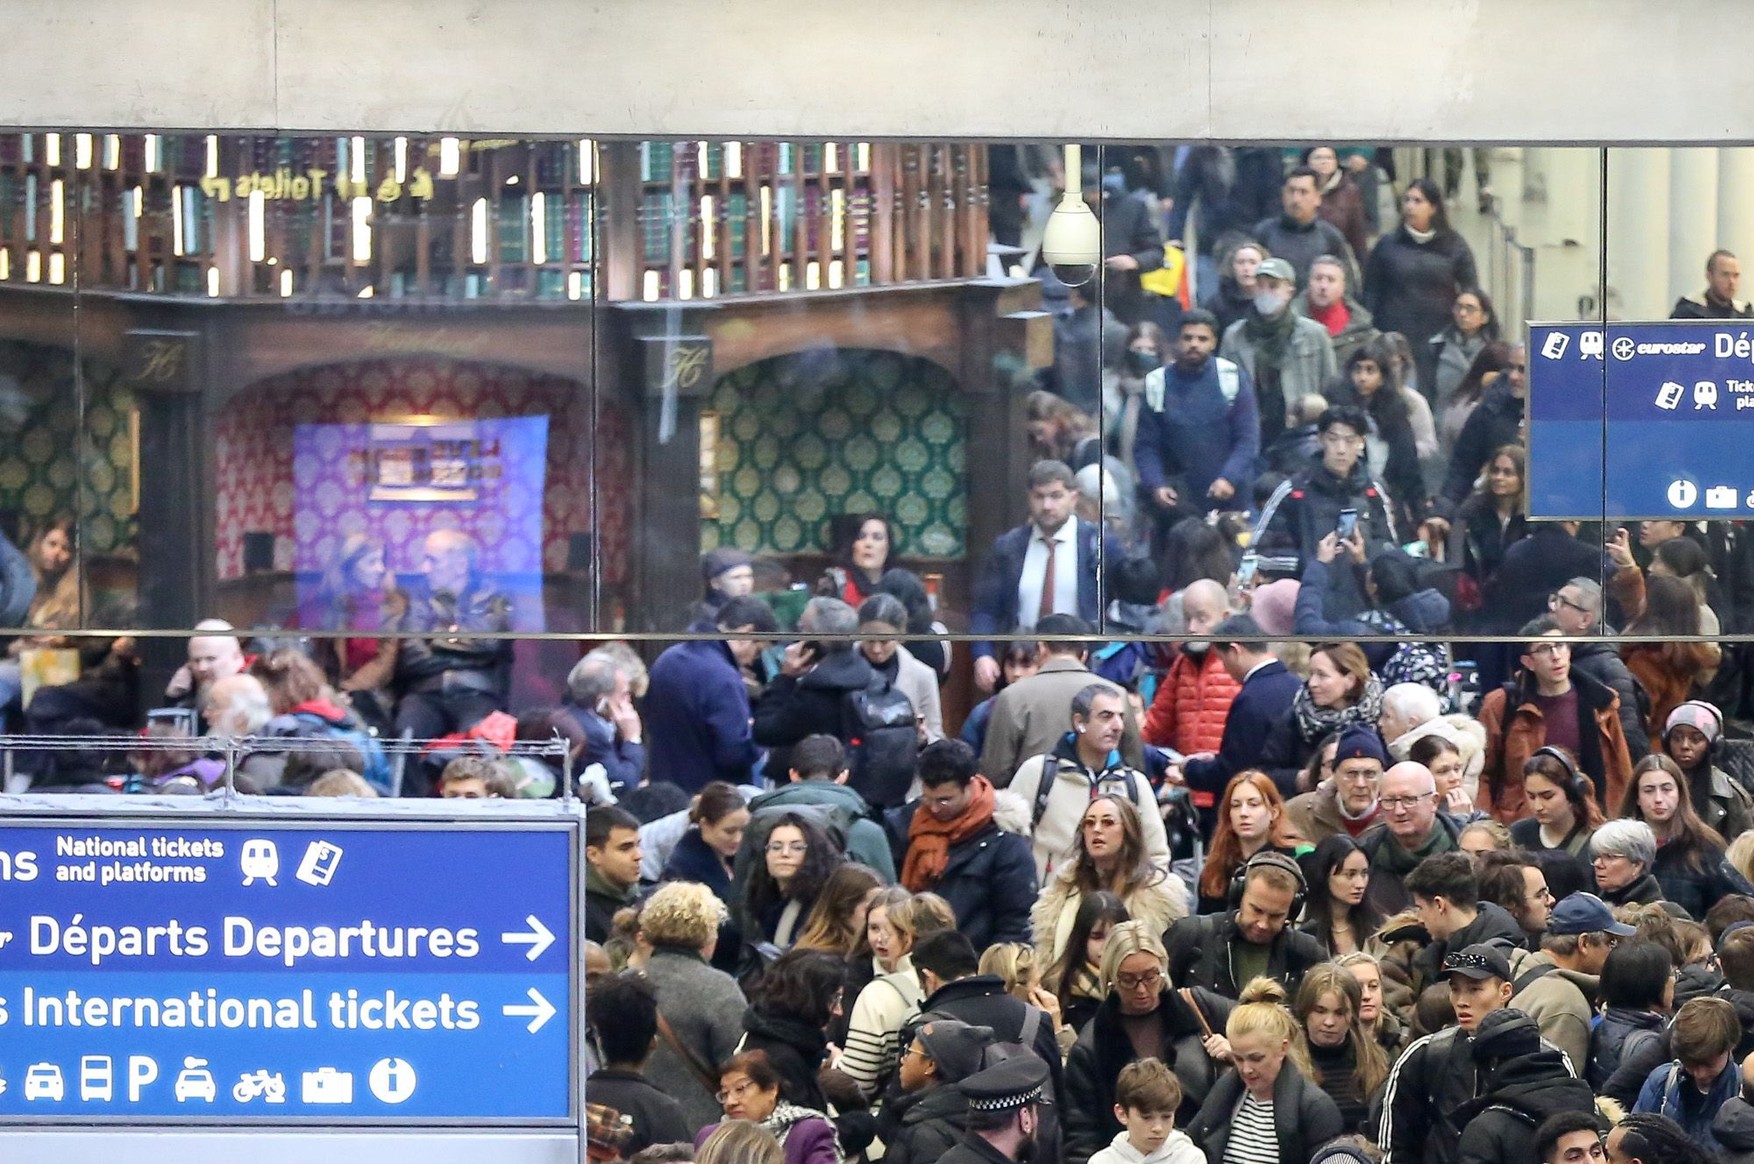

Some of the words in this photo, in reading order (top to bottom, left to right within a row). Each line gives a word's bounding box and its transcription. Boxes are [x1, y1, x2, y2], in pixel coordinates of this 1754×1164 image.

[56, 835, 147, 857] National
[151, 836, 224, 858] tickets
[56, 861, 96, 882] and
[101, 861, 207, 886] platforms
[30, 914, 209, 965] Départs
[223, 917, 480, 967] Departures
[23, 987, 317, 1029] International
[328, 989, 481, 1031] tickets
